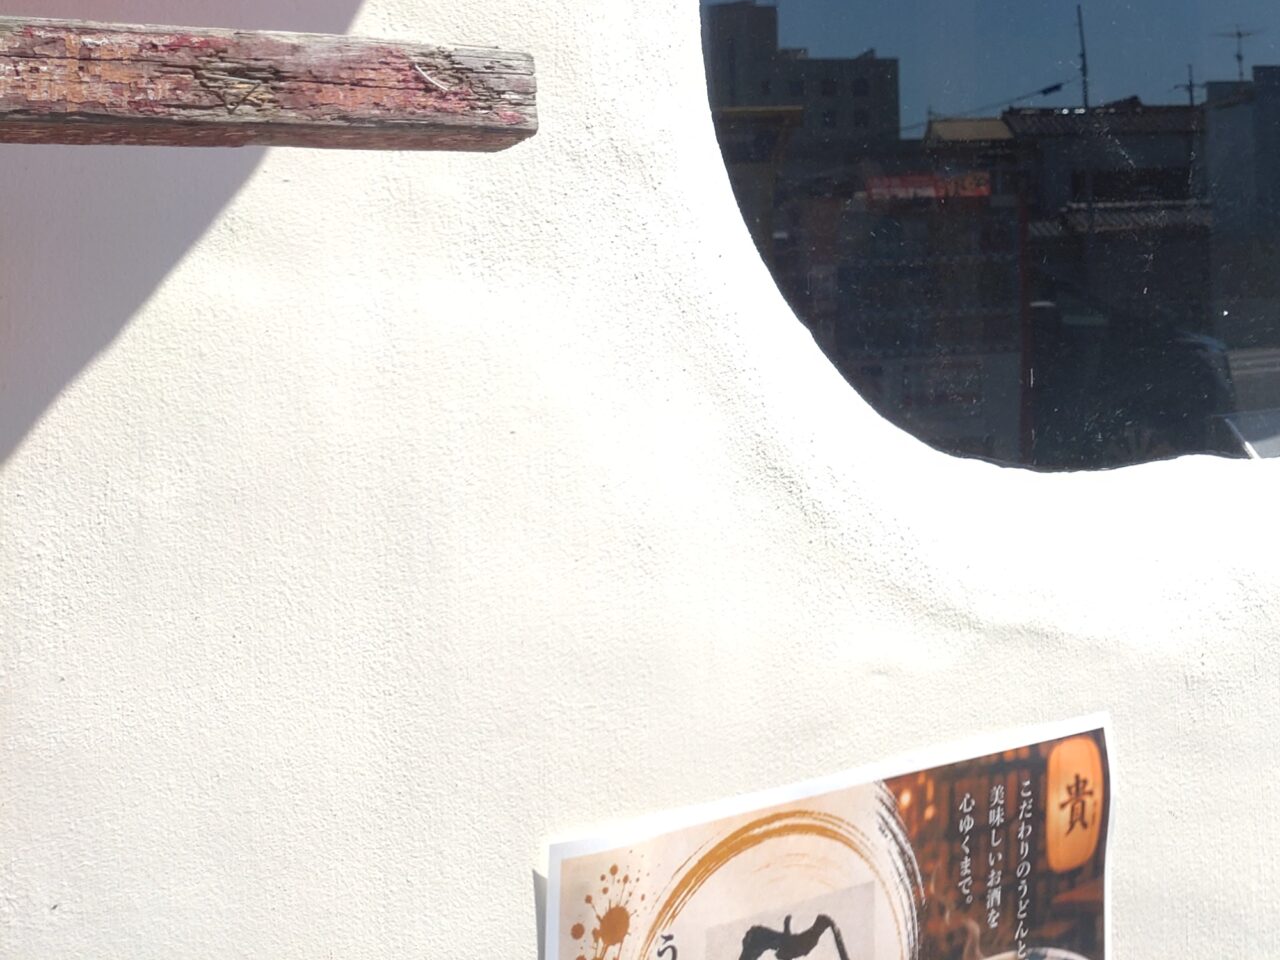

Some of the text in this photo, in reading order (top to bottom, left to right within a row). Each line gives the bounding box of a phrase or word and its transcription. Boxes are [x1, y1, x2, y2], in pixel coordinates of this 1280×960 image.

[957, 792, 976, 905] 心ゆくまで。
[987, 784, 1006, 929] 美味しいお酒を
[1059, 773, 1094, 836] 貴
